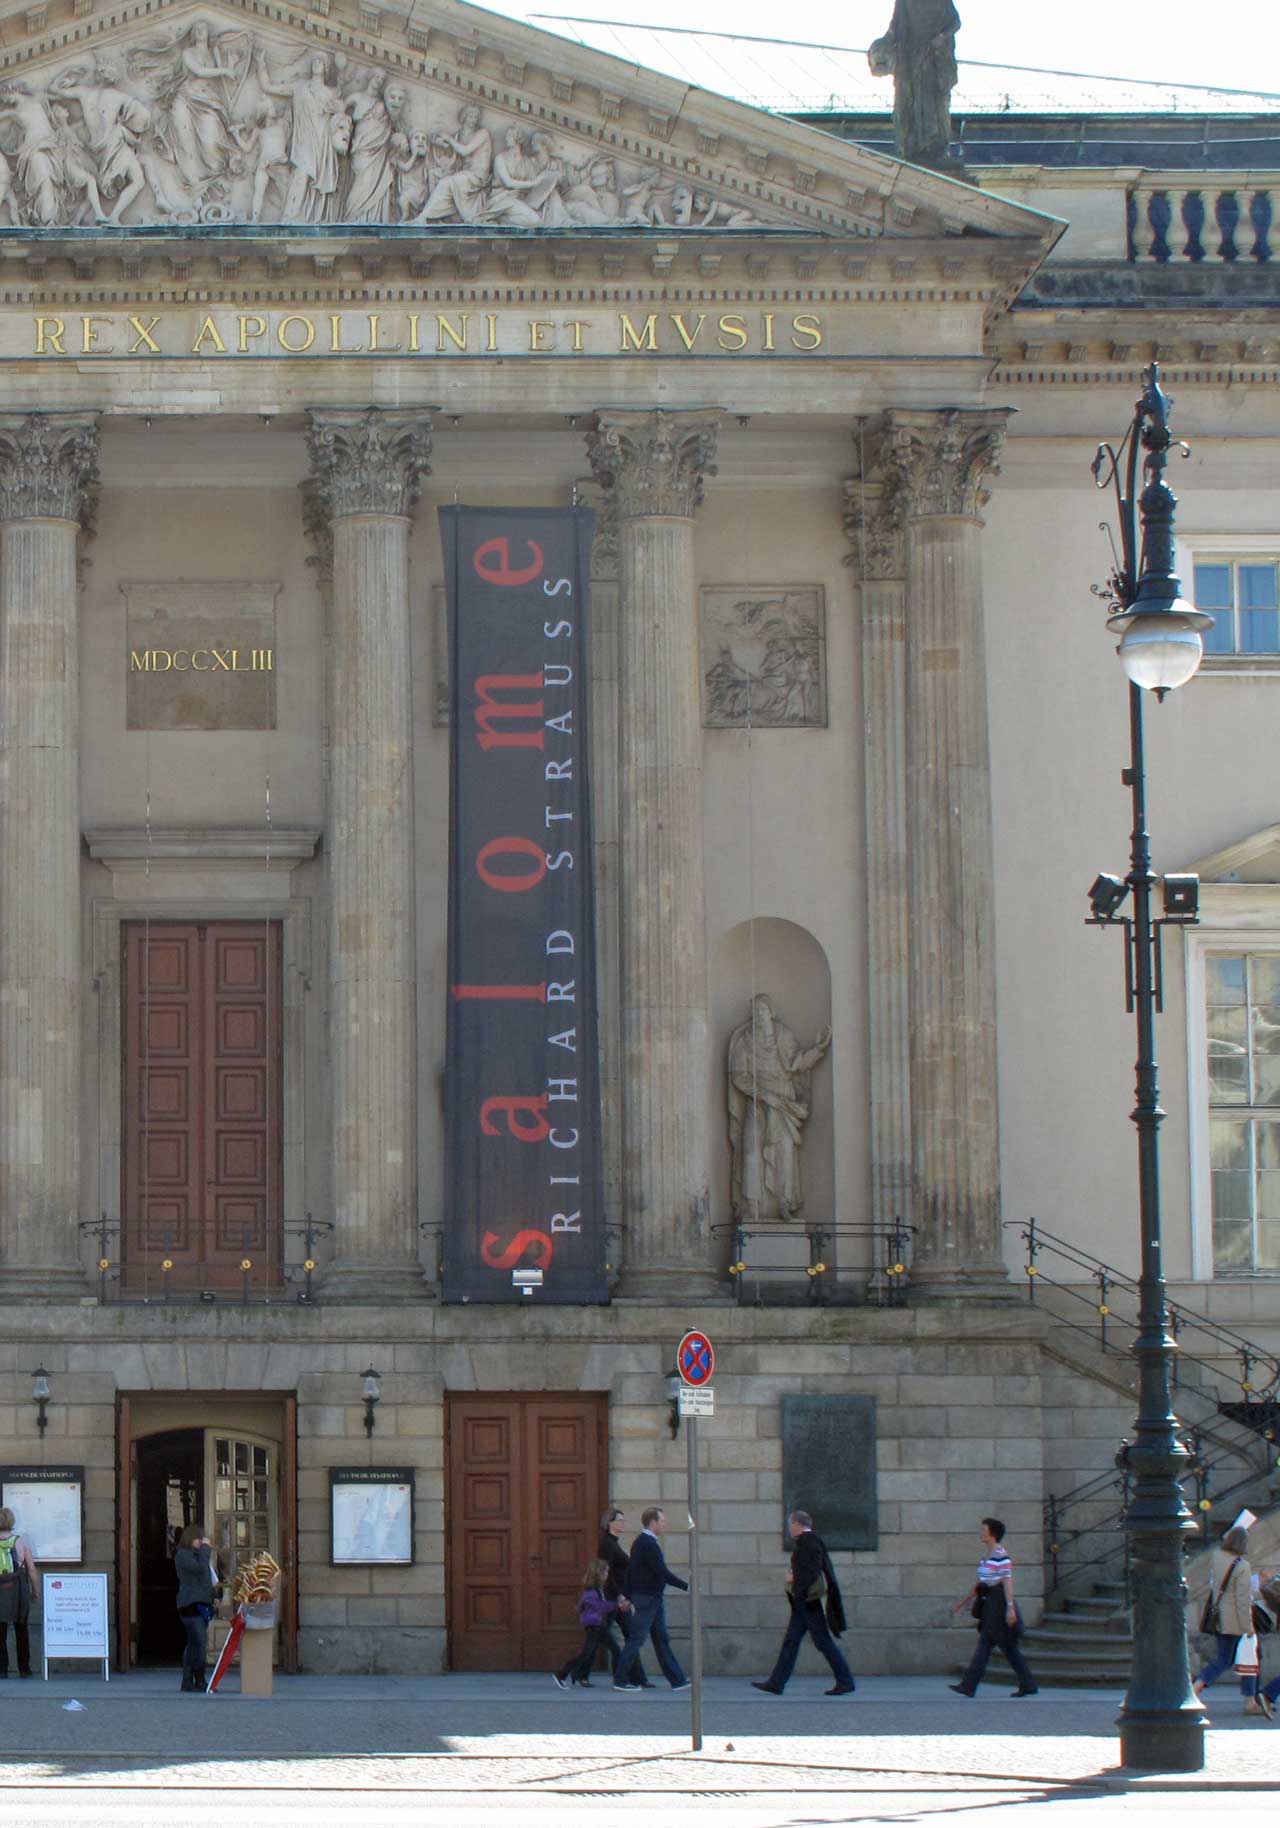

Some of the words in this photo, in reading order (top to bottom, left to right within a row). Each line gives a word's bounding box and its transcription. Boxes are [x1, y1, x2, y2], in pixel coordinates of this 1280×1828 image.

[34, 316, 162, 355] REX
[191, 314, 500, 353] APOLLINI
[528, 320, 593, 351] ET
[619, 313, 823, 352] MVSIS
[130, 650, 273, 672] MDCCXLIII
[543, 576, 574, 871] STRAUSS
[450, 535, 553, 1270] salome
[546, 929, 582, 1236] RICHARD
